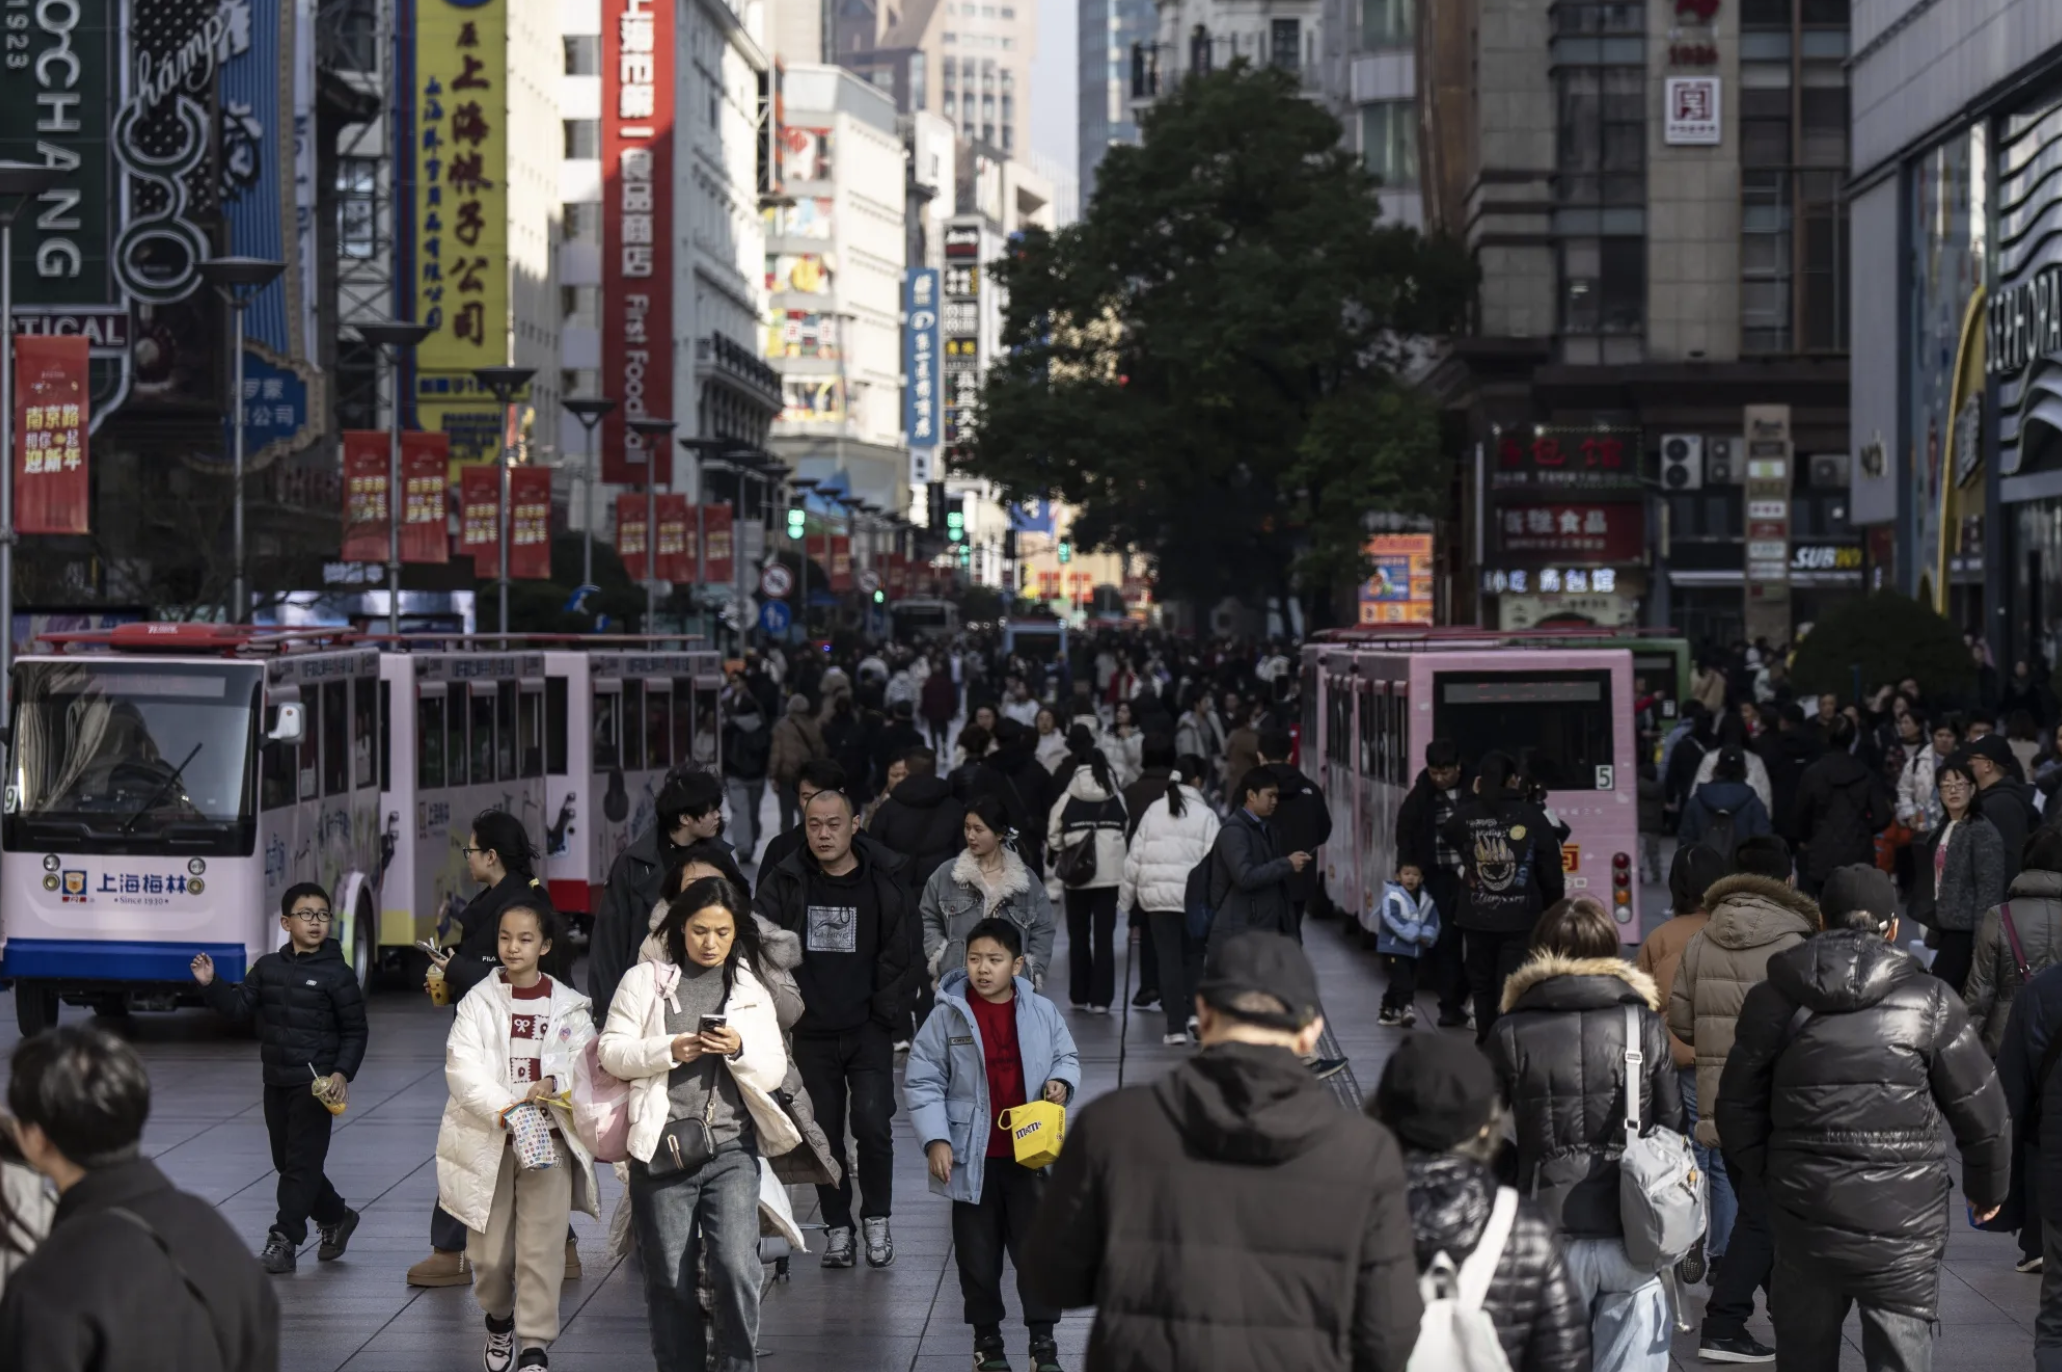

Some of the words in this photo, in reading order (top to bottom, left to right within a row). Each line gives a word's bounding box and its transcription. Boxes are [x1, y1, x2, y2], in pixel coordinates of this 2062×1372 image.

[625, 294, 650, 343] First
[25, 404, 80, 430] 南京路
[24, 447, 82, 474] 迎新年
[1598, 766, 1611, 789] 5
[97, 873, 188, 894] 上海梅林
[119, 896, 142, 905] Since
[144, 897, 165, 906] 1930
[482, 955, 497, 963] FILA
